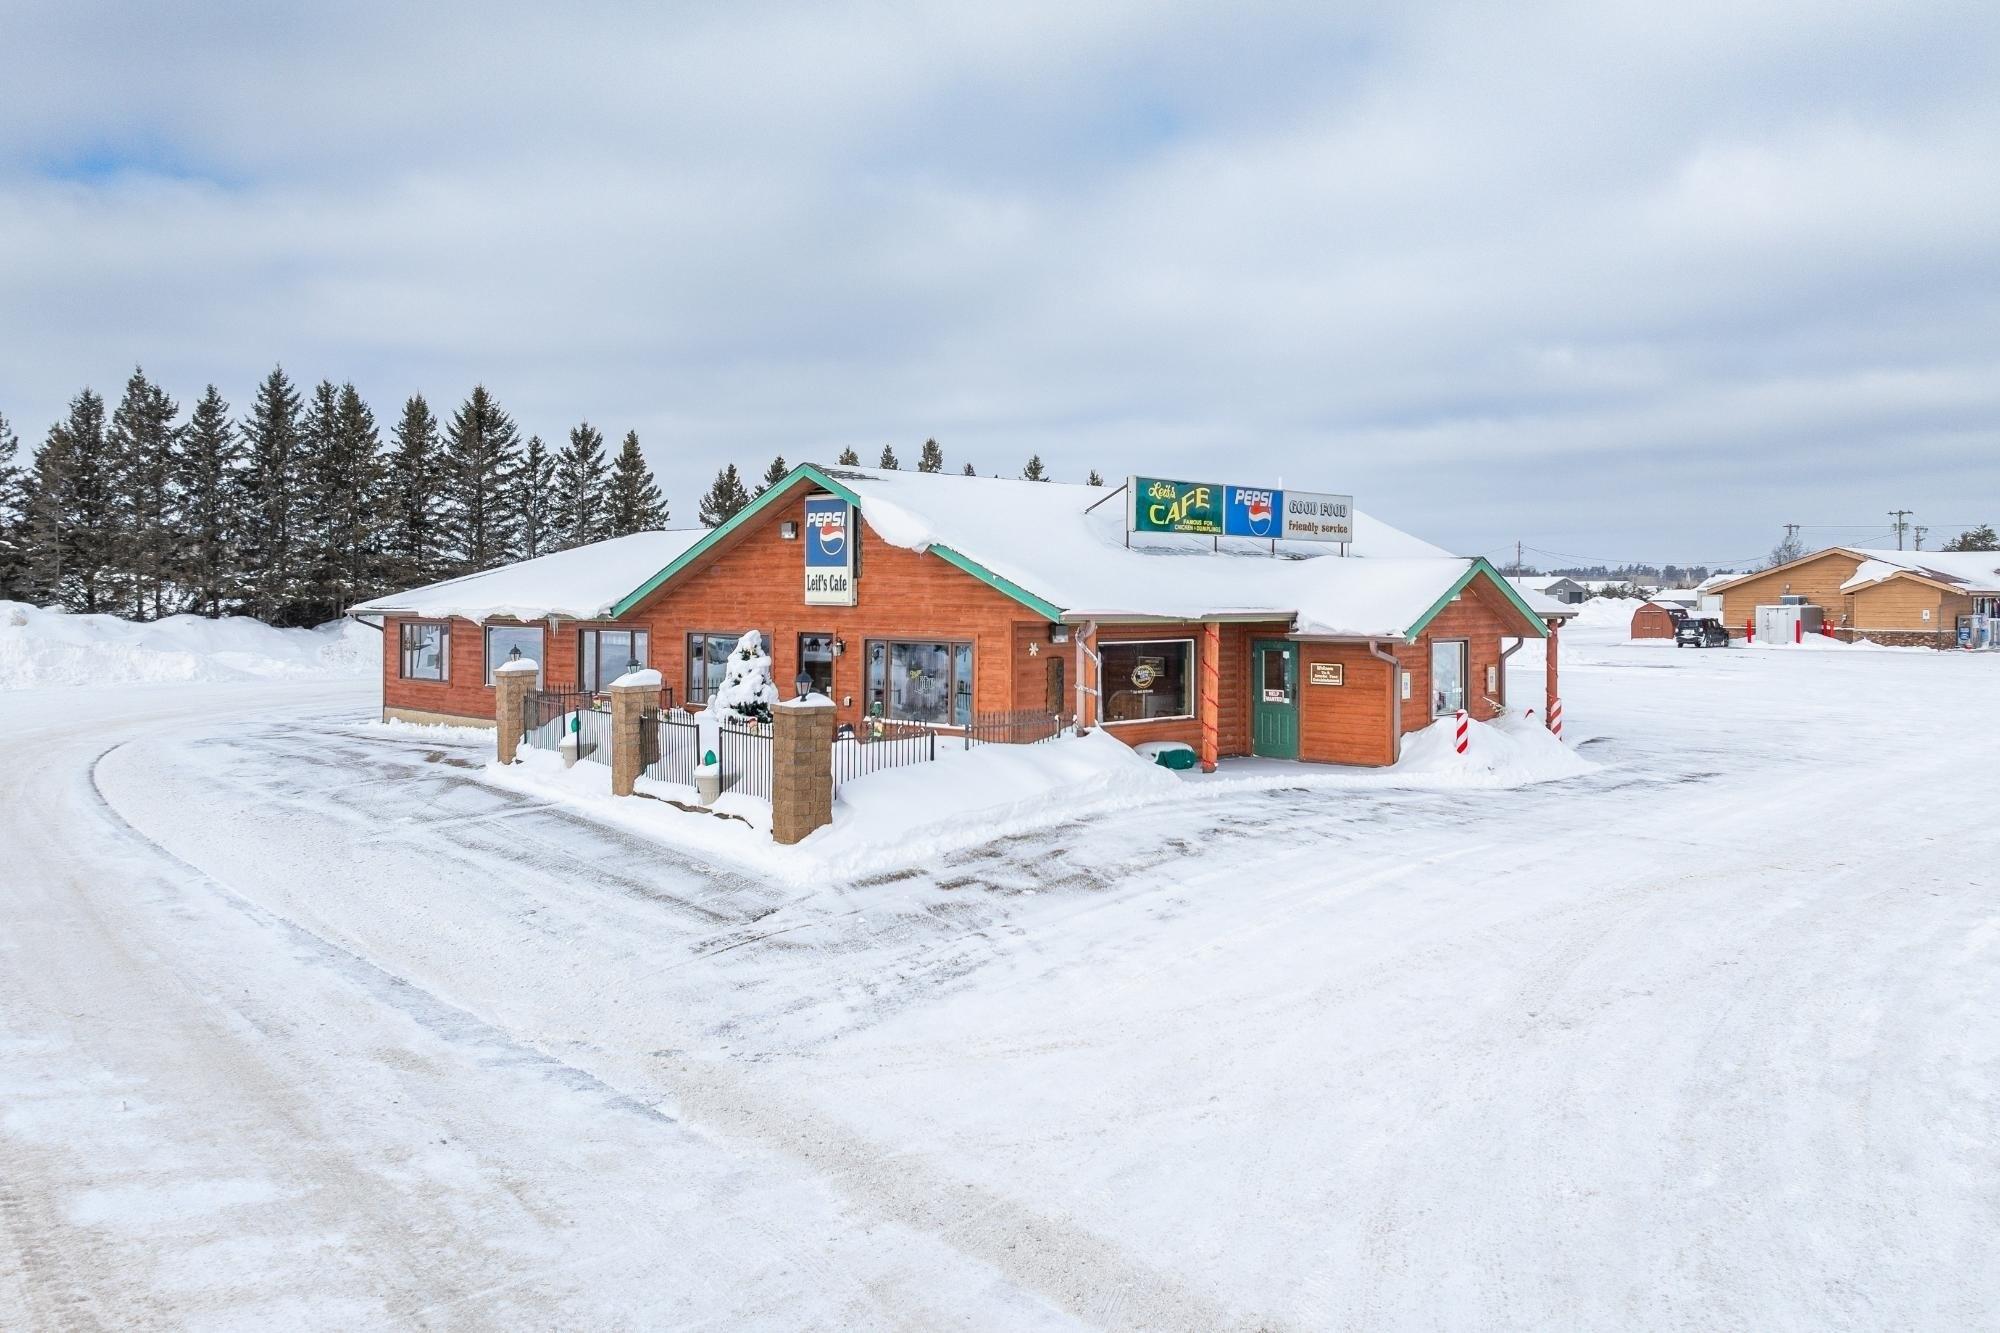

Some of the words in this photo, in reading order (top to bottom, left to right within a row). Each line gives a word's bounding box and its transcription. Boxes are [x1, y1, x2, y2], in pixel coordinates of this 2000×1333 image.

[1149, 487, 1210, 525] CAFE
[1234, 489, 1273, 506] PEPSI
[1289, 500, 1318, 516] GOOD
[1320, 502, 1347, 518] FOOD
[807, 512, 845, 527] PEPSI
[1321, 522, 1348, 534] service
[807, 574, 827, 592] Leif's
[829, 574, 847, 592] Cafe
